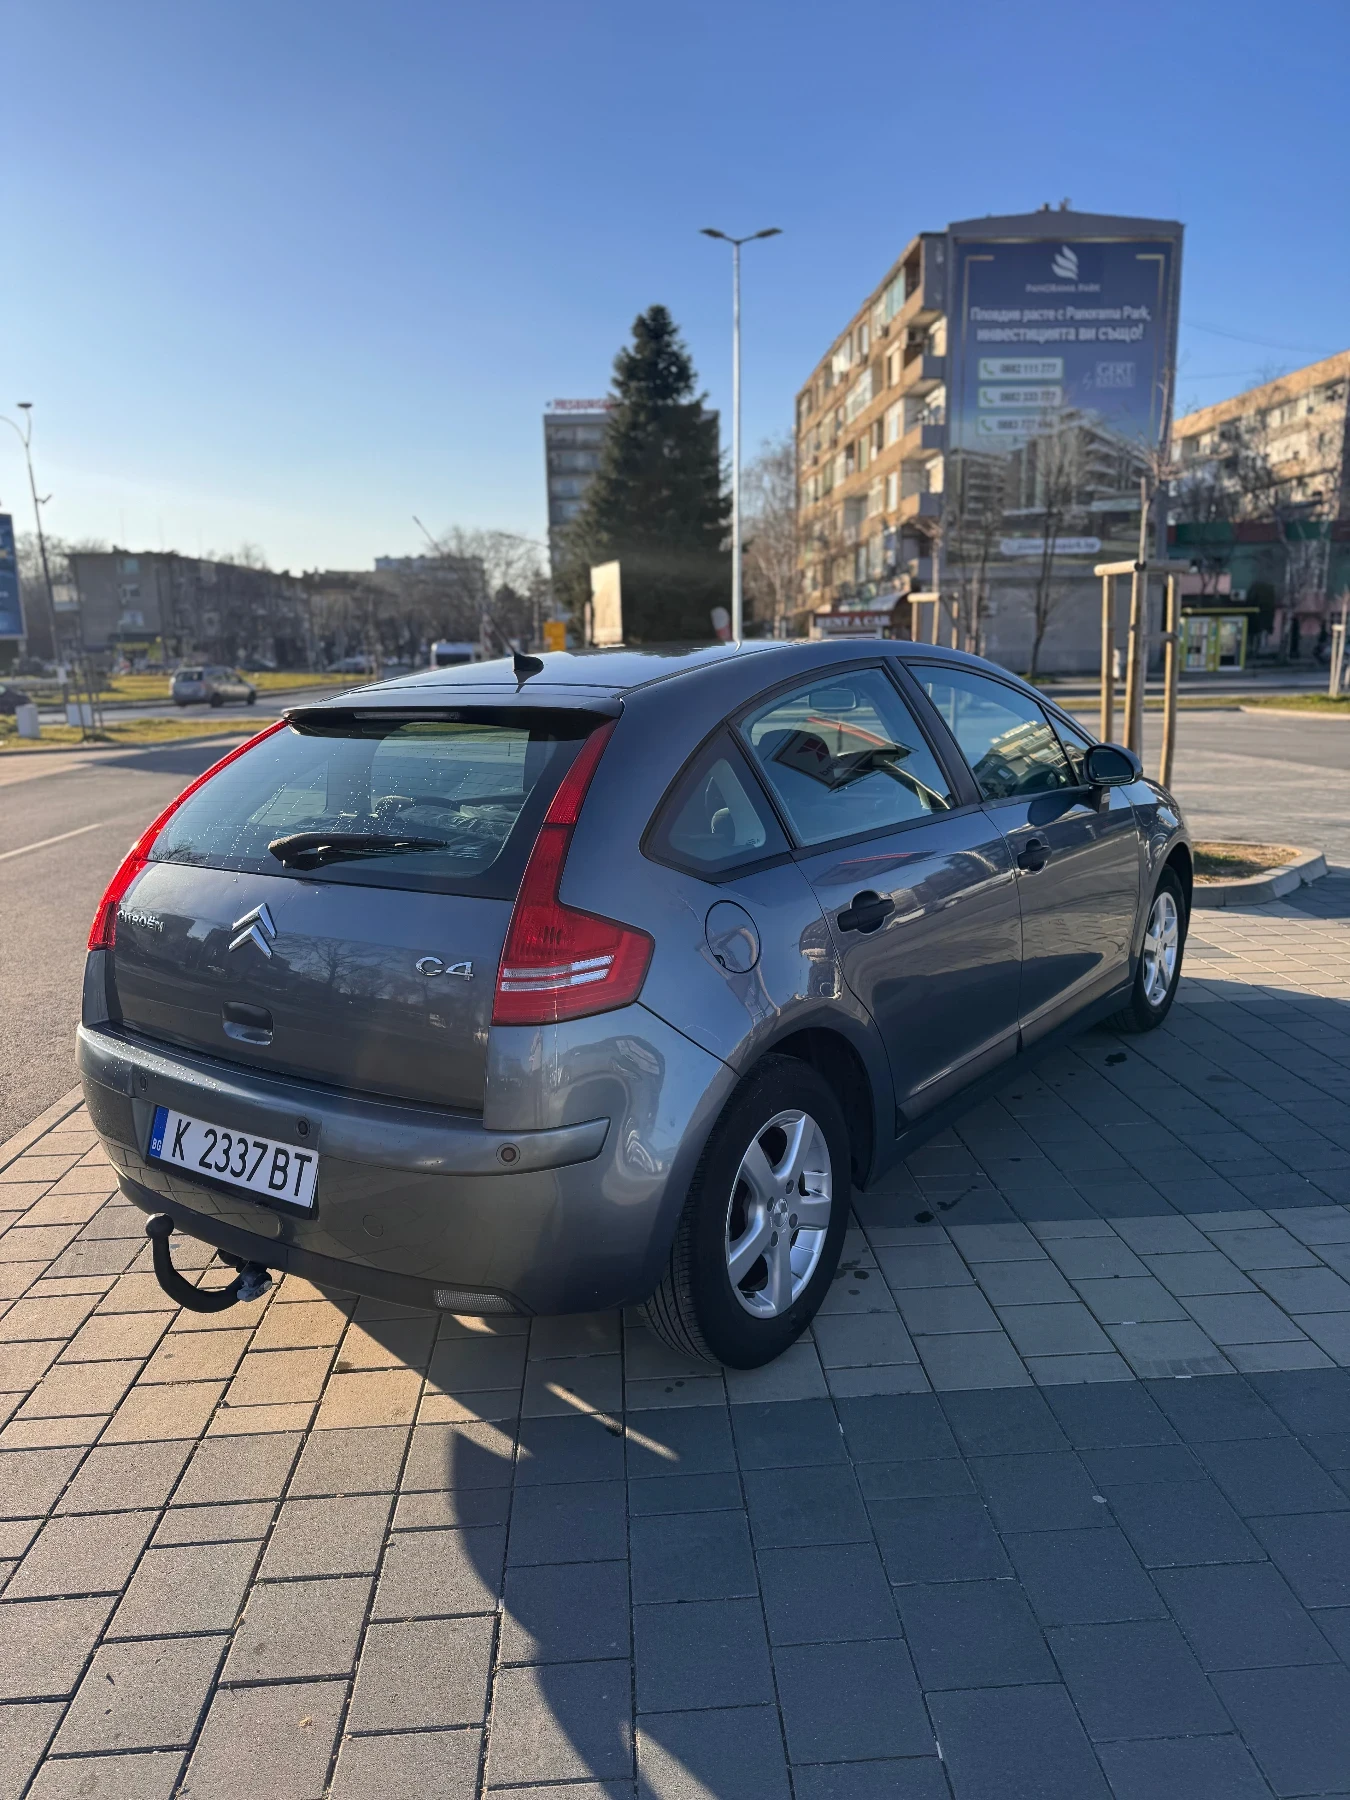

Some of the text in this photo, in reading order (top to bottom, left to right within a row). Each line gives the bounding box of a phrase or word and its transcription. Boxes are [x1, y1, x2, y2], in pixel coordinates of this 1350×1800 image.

[1066, 306, 1121, 320] Panorama
[415, 956, 474, 981] C4
[151, 1138, 162, 1151] BG
[172, 1118, 192, 1161] K
